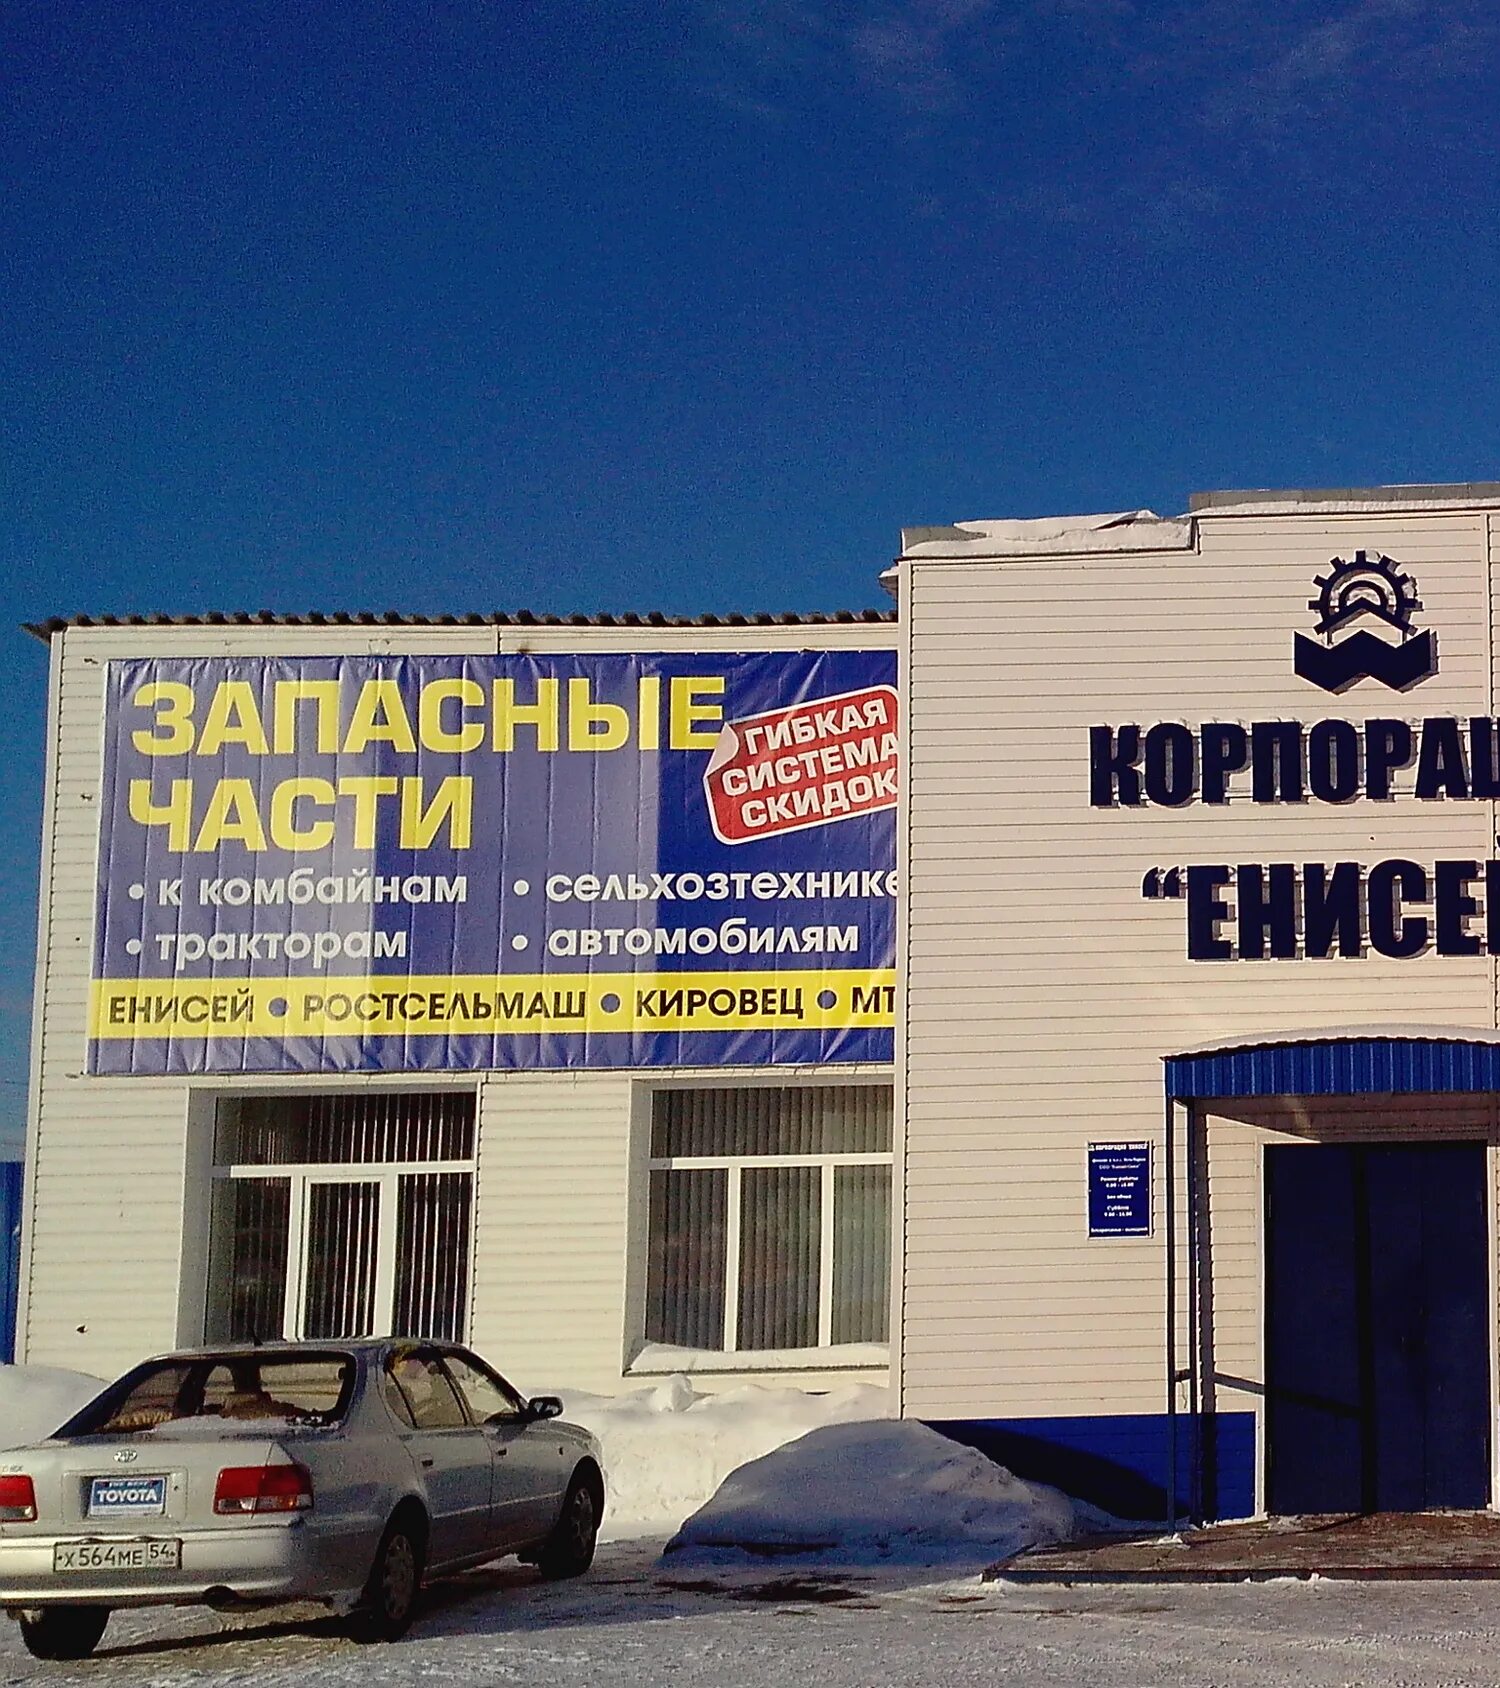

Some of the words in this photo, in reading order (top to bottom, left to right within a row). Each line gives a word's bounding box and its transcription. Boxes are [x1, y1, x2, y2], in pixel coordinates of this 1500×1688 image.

[131, 676, 726, 759] ЗАПАСНЫЕ
[744, 698, 889, 755] ГИБКАЯ
[721, 731, 900, 796] СИСТЕМА
[128, 775, 473, 854] ЧАСТИ
[740, 767, 899, 828] СКИДОК
[158, 878, 184, 906] к
[198, 867, 468, 906] комбайнам
[545, 869, 898, 903] сельхозтехнике
[155, 929, 408, 971] тракторам
[547, 917, 860, 957] автомобилям
[108, 987, 255, 1025] ЕНИСЕЙ
[302, 990, 587, 1023] РОСТСЕЛЬМАШ
[635, 987, 804, 1021] КИРОВЕЦ
[97, 1489, 158, 1503] TOYOTA
[150, 1543, 171, 1559] 54
